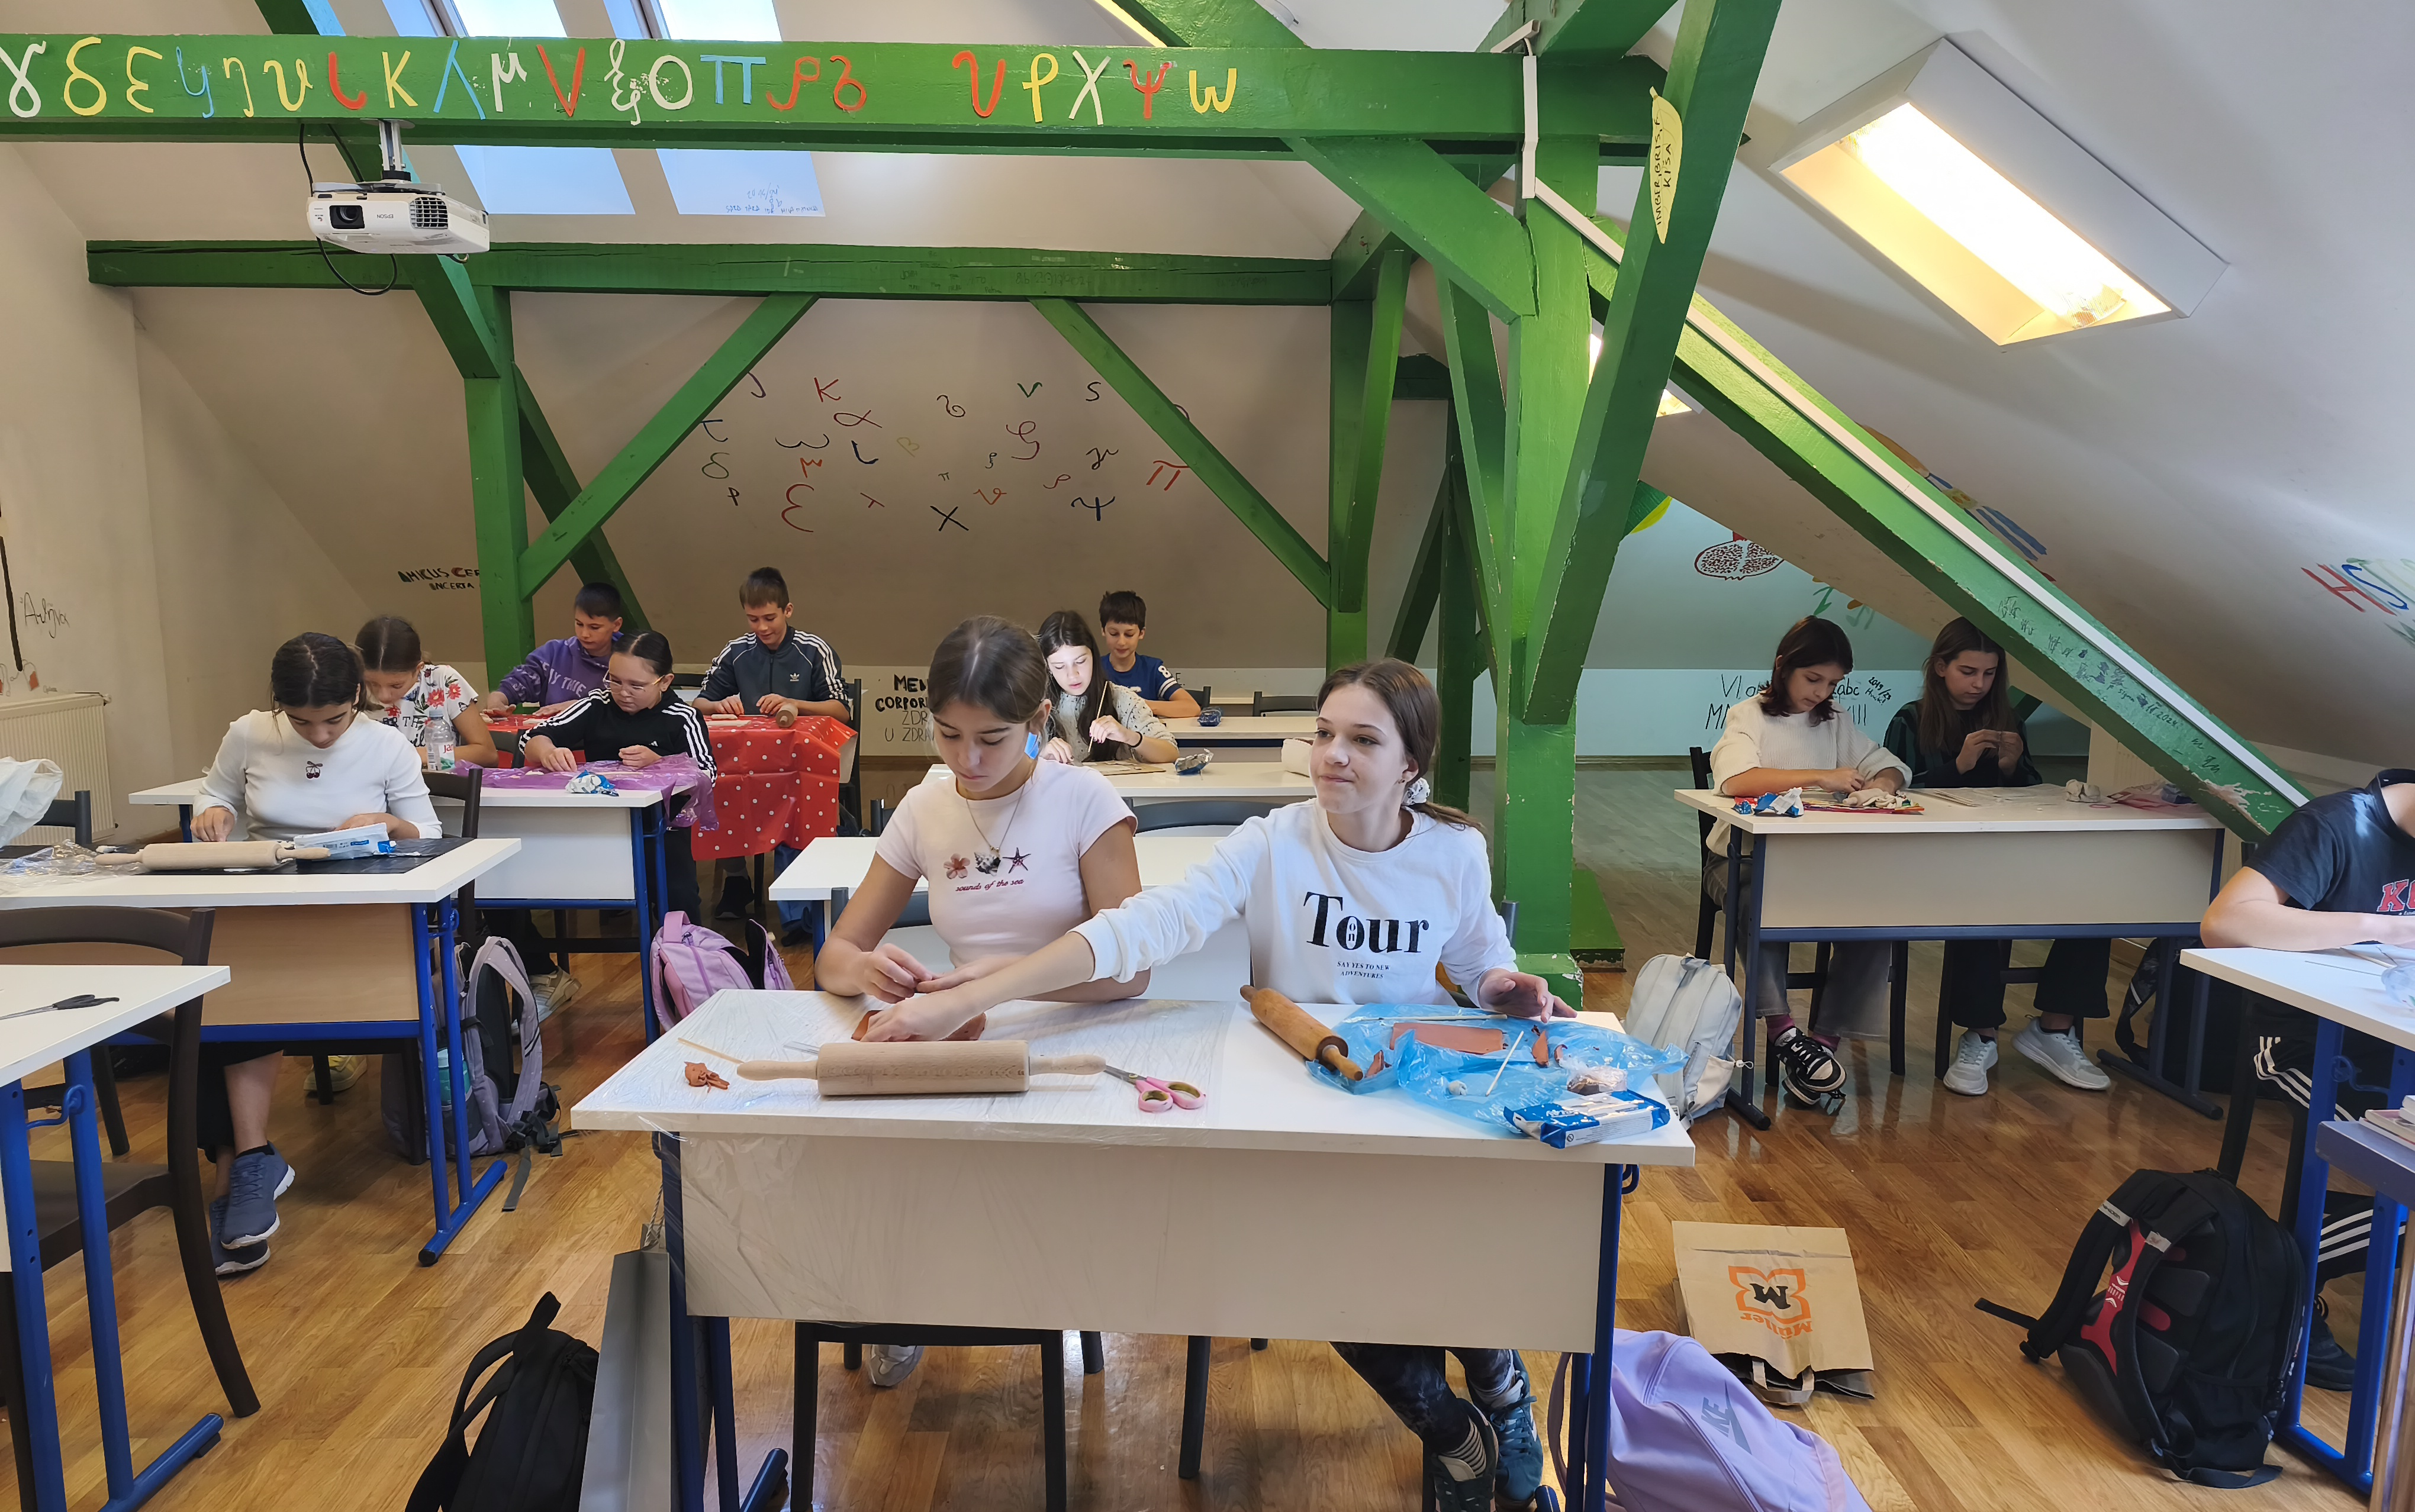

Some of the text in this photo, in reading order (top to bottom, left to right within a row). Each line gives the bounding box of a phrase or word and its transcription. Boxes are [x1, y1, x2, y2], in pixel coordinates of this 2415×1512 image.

[955, 882, 981, 891] sounds
[984, 880, 996, 891] of
[1303, 891, 1429, 953] Tour
[1340, 971, 1384, 979] ADVENTURES
[1740, 1313, 1814, 1340] Müller
